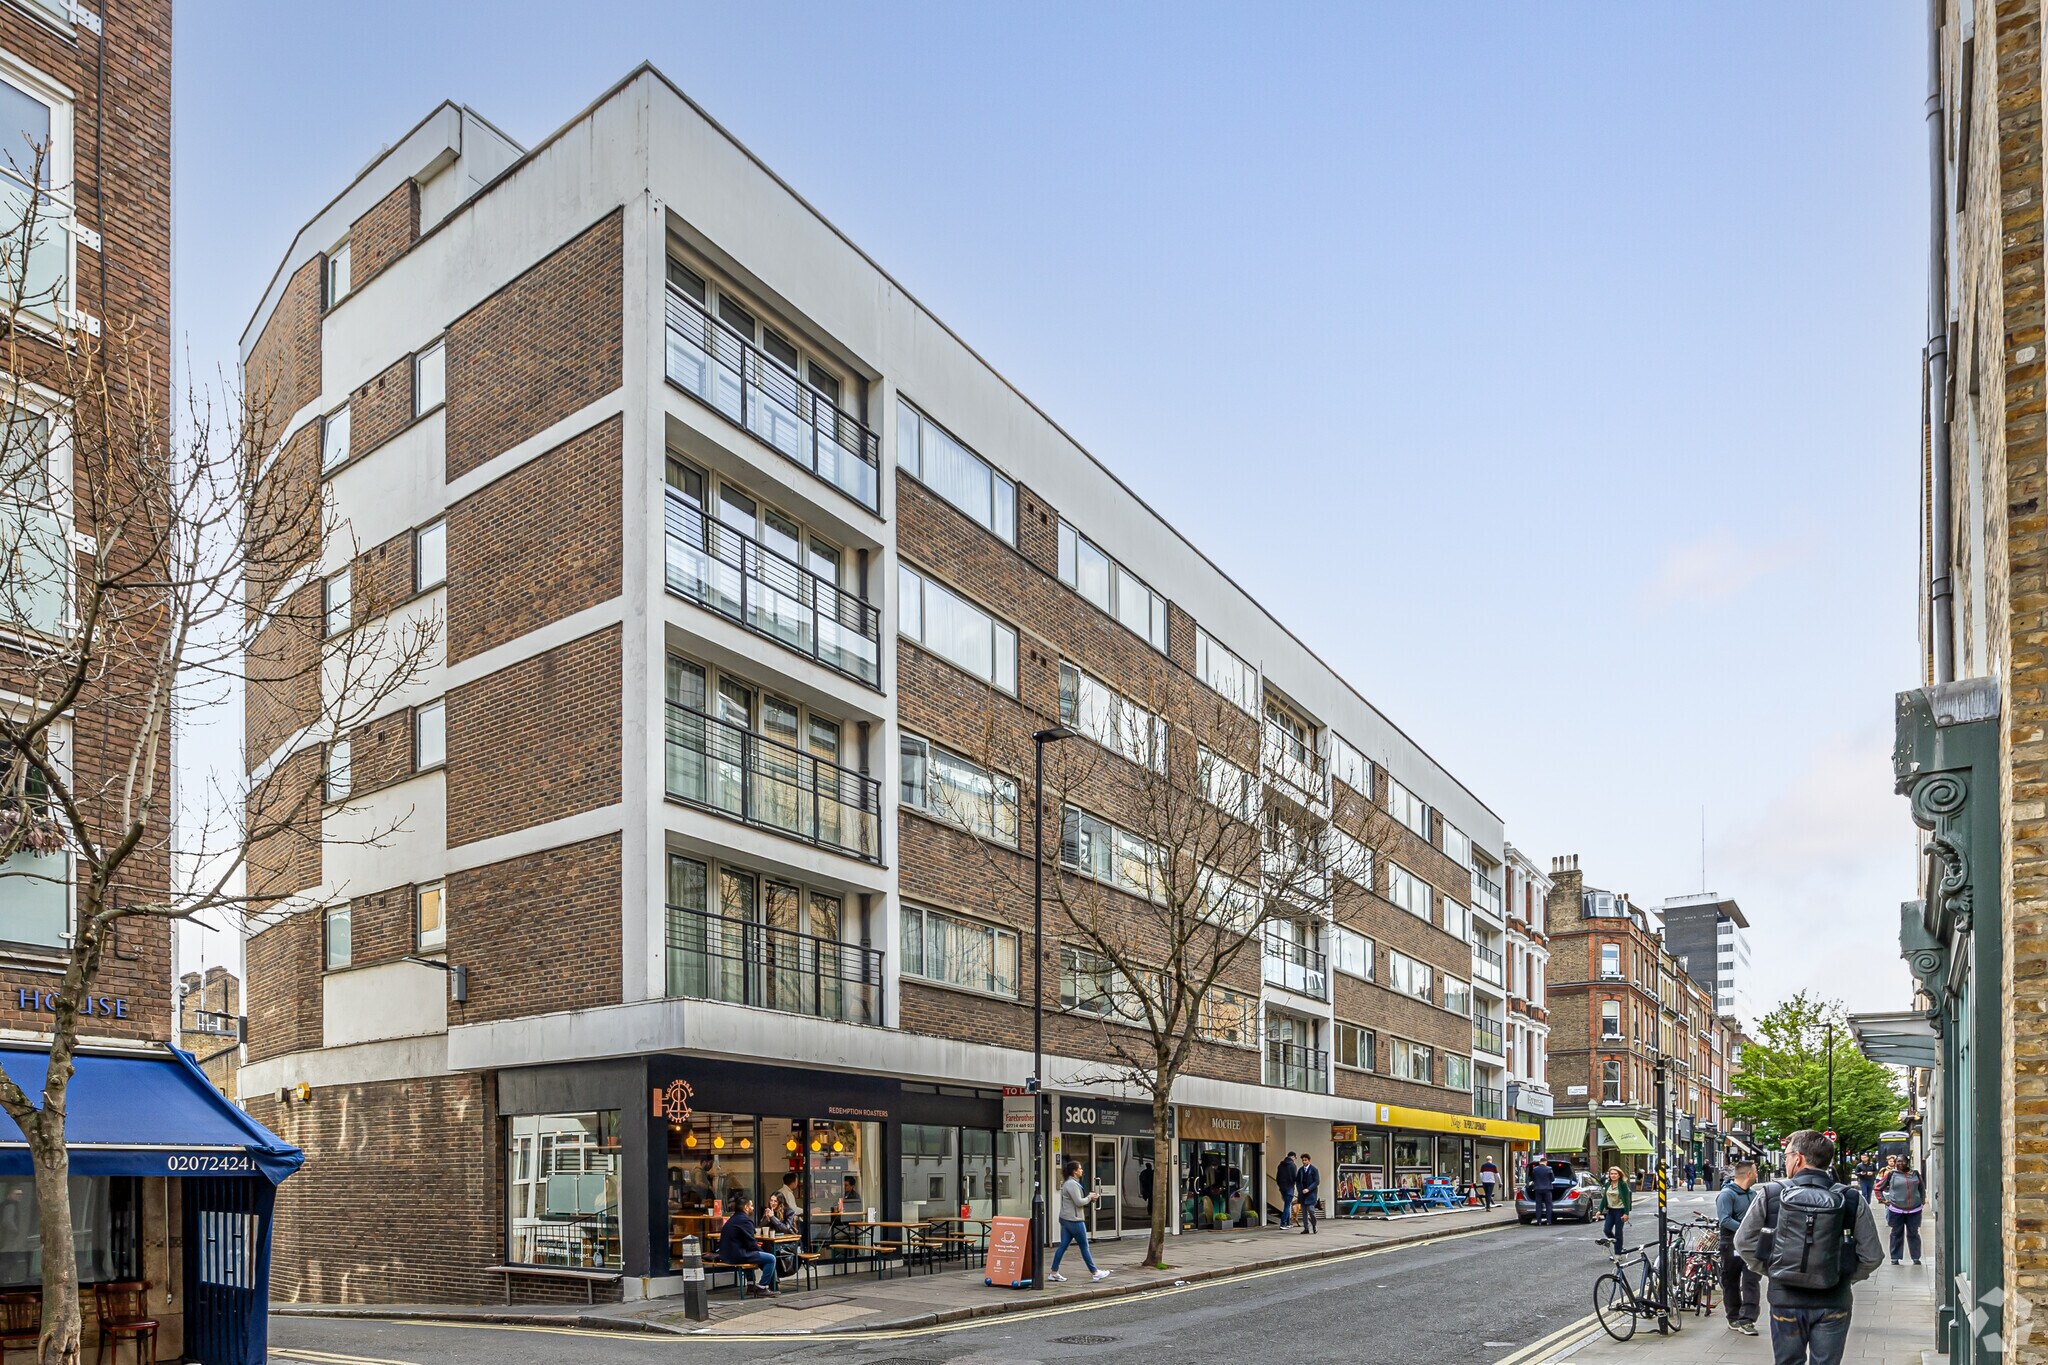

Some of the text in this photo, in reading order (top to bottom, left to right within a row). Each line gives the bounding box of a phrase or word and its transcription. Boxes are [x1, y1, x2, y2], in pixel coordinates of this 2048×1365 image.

[1005, 1087, 1017, 1095] TO
[828, 1106, 888, 1117] REDEMPTION ROASTERS
[1065, 1106, 1096, 1124] saco
[1211, 1118, 1240, 1130] MOCHEE
